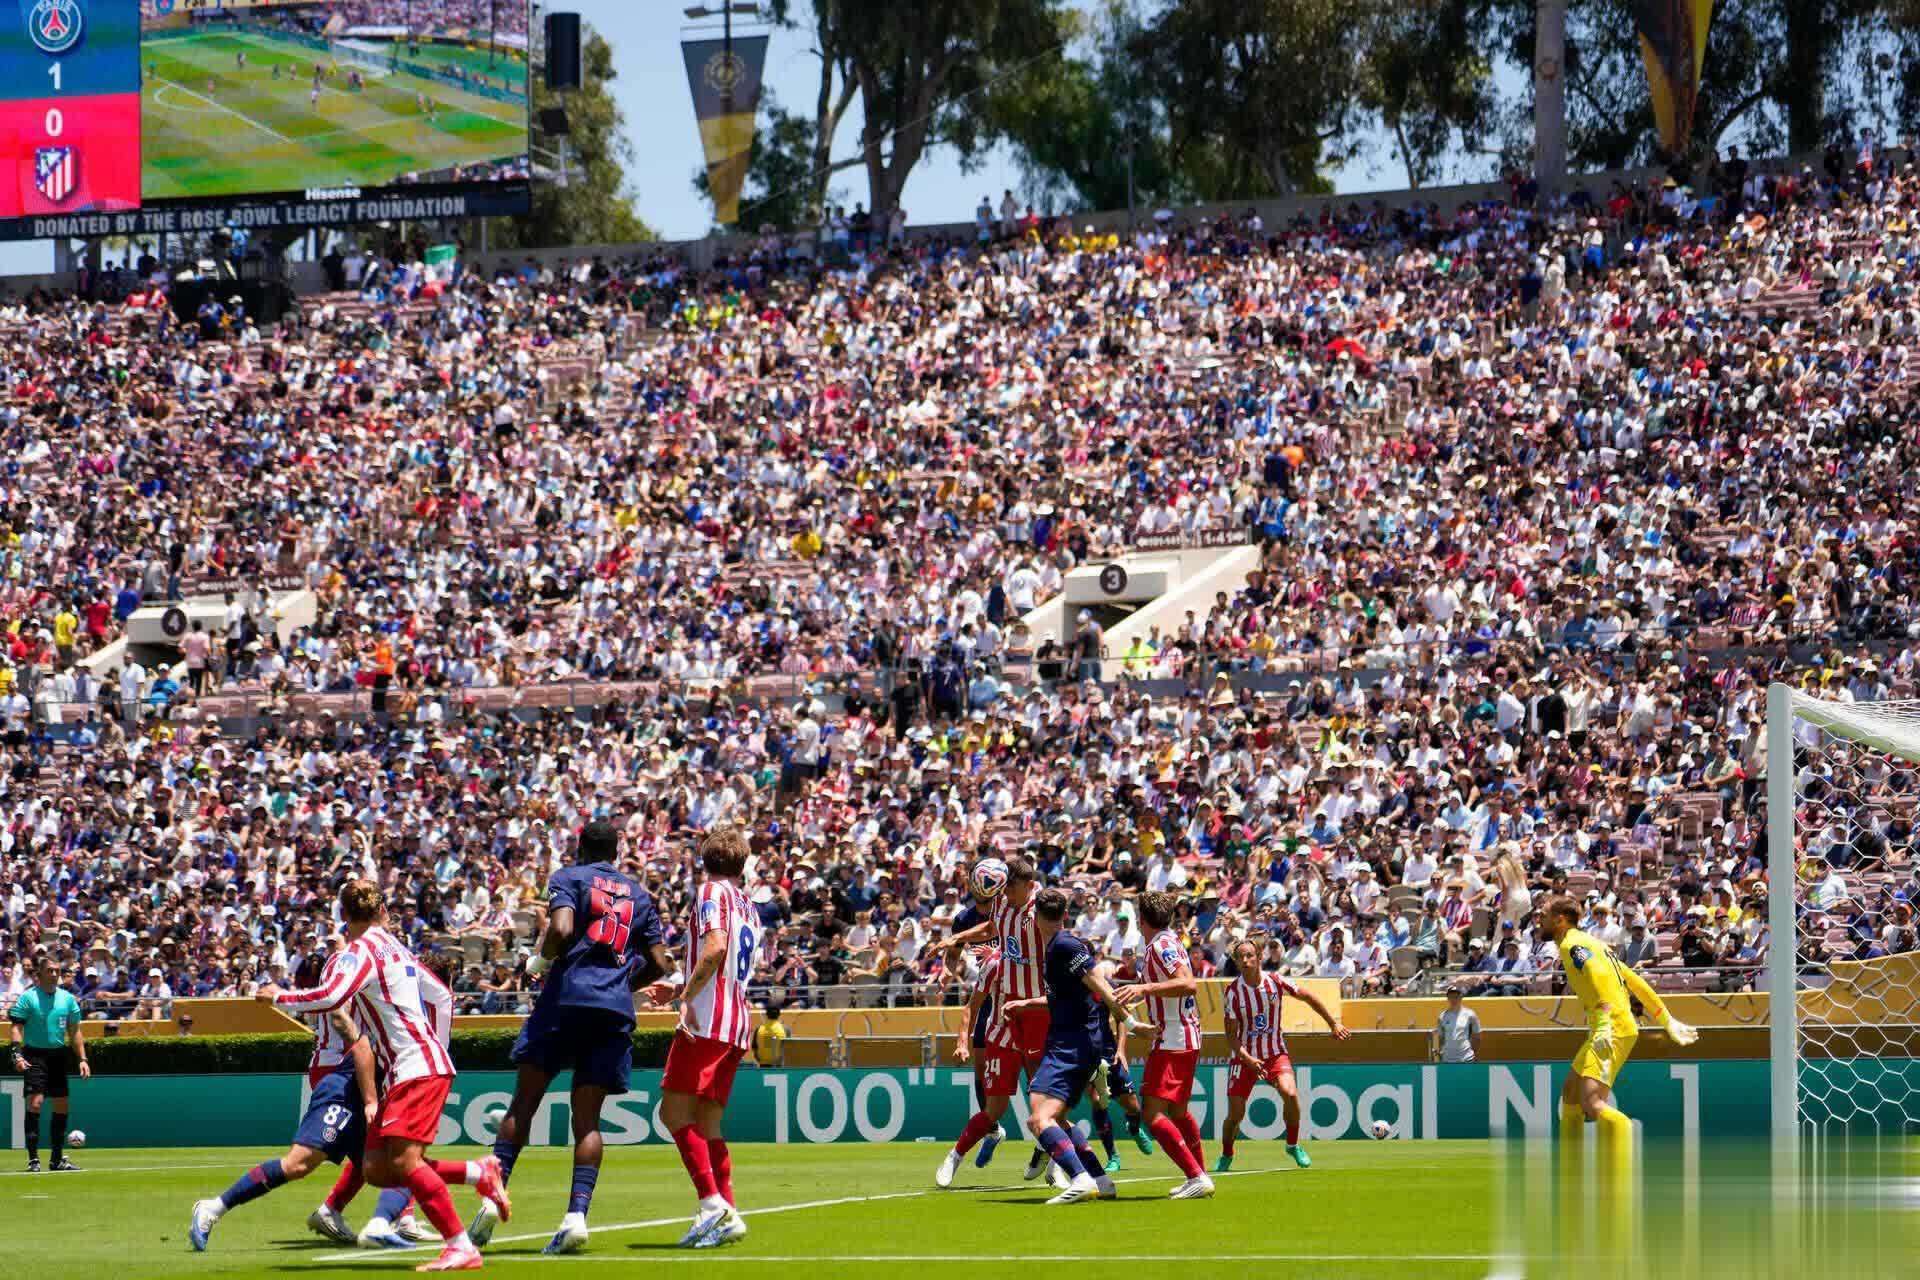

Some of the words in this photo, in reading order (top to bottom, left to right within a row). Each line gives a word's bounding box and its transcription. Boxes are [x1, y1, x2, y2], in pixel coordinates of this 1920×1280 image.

[48, 61, 61, 90] 1
[45, 108, 63, 137] 0
[305, 187, 361, 201] Hisense
[34, 217, 110, 237] DONATED
[116, 215, 137, 232] BY
[144, 212, 175, 230] THE
[181, 210, 224, 228] ROSE
[232, 208, 280, 226] BOWL
[285, 203, 350, 223] LEGACY
[357, 197, 465, 219] FOUNDATION
[1107, 570, 1120, 590] 3
[168, 612, 180, 631] 4
[587, 887, 634, 956] 51
[737, 924, 755, 981] 8
[984, 1058, 1001, 1078] 24
[1670, 1063, 1699, 1141] 1
[323, 1103, 353, 1131] 87
